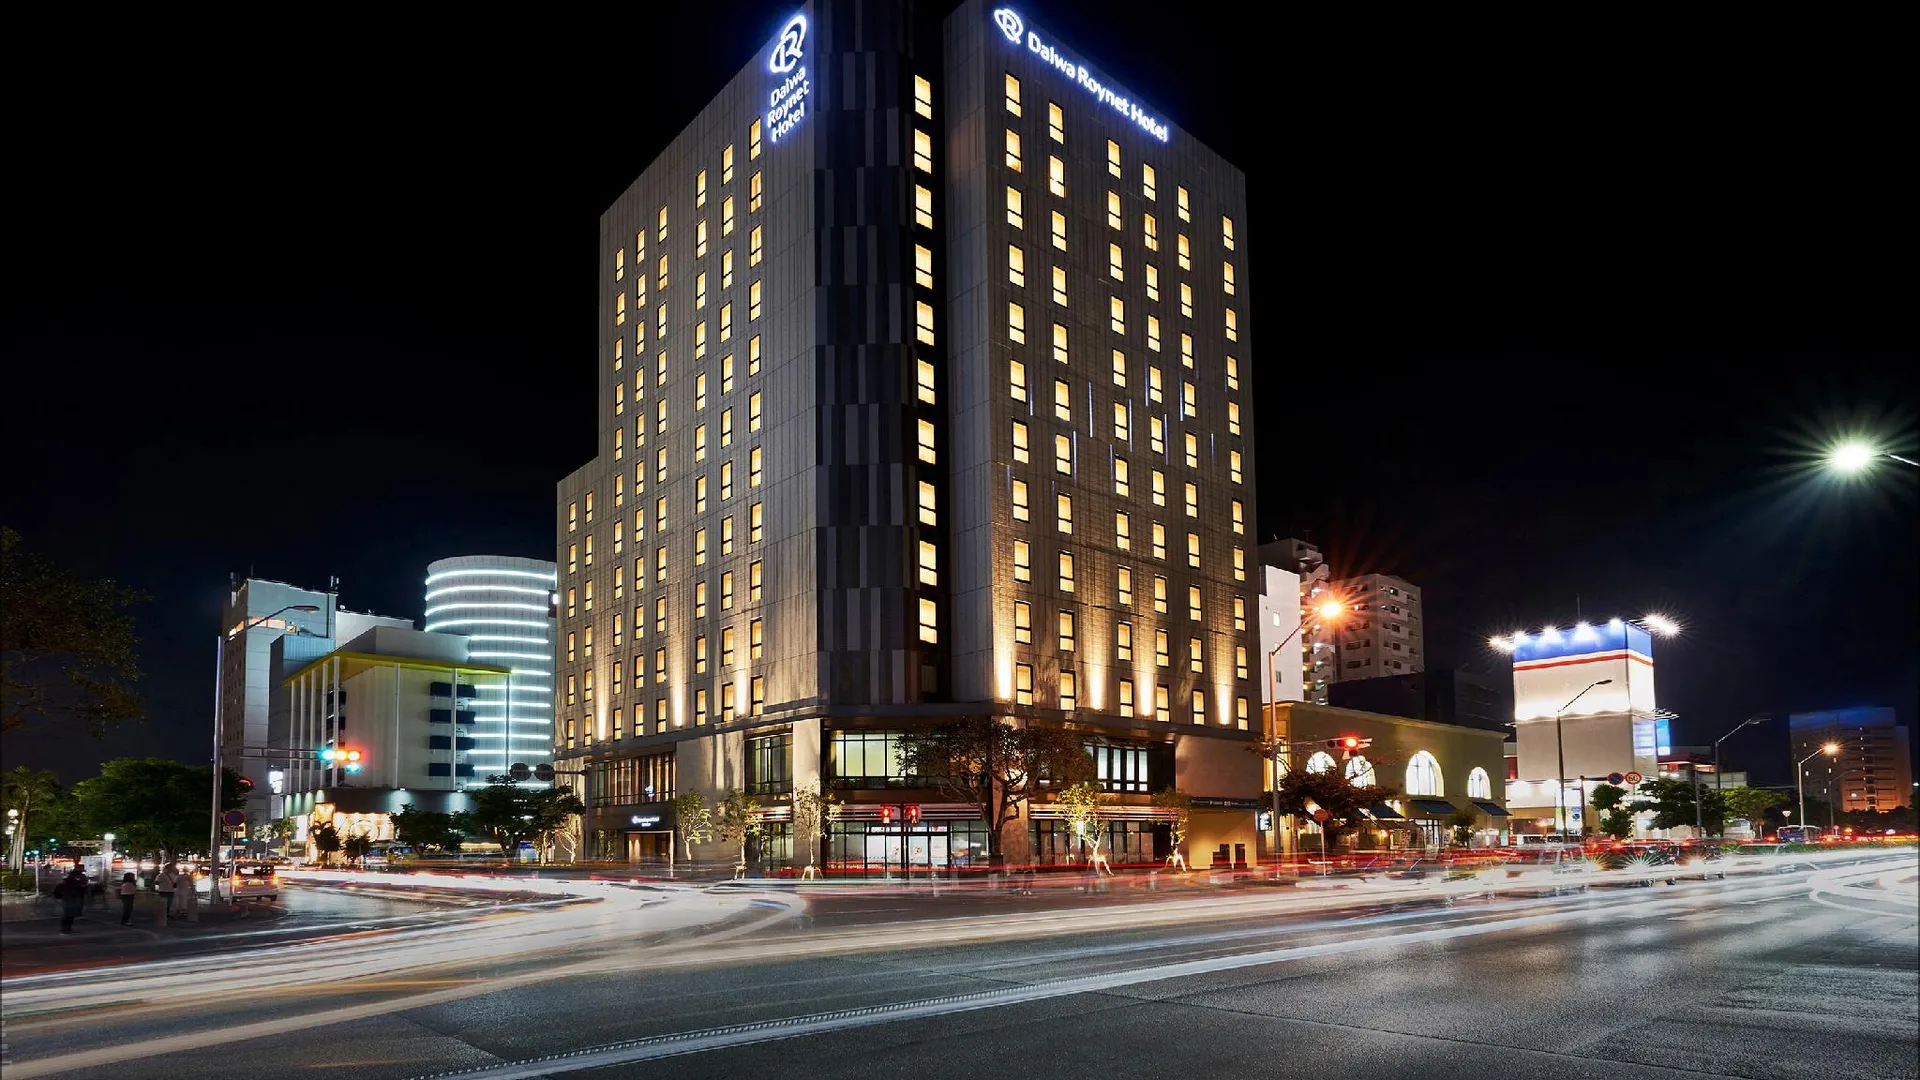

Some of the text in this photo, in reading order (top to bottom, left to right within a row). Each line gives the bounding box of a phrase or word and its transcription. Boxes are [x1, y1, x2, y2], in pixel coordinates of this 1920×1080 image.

[767, 80, 810, 128] Roynet
[771, 101, 805, 142] Hotel
[1077, 65, 1130, 116] Roynet
[1131, 104, 1168, 142] Hotel
